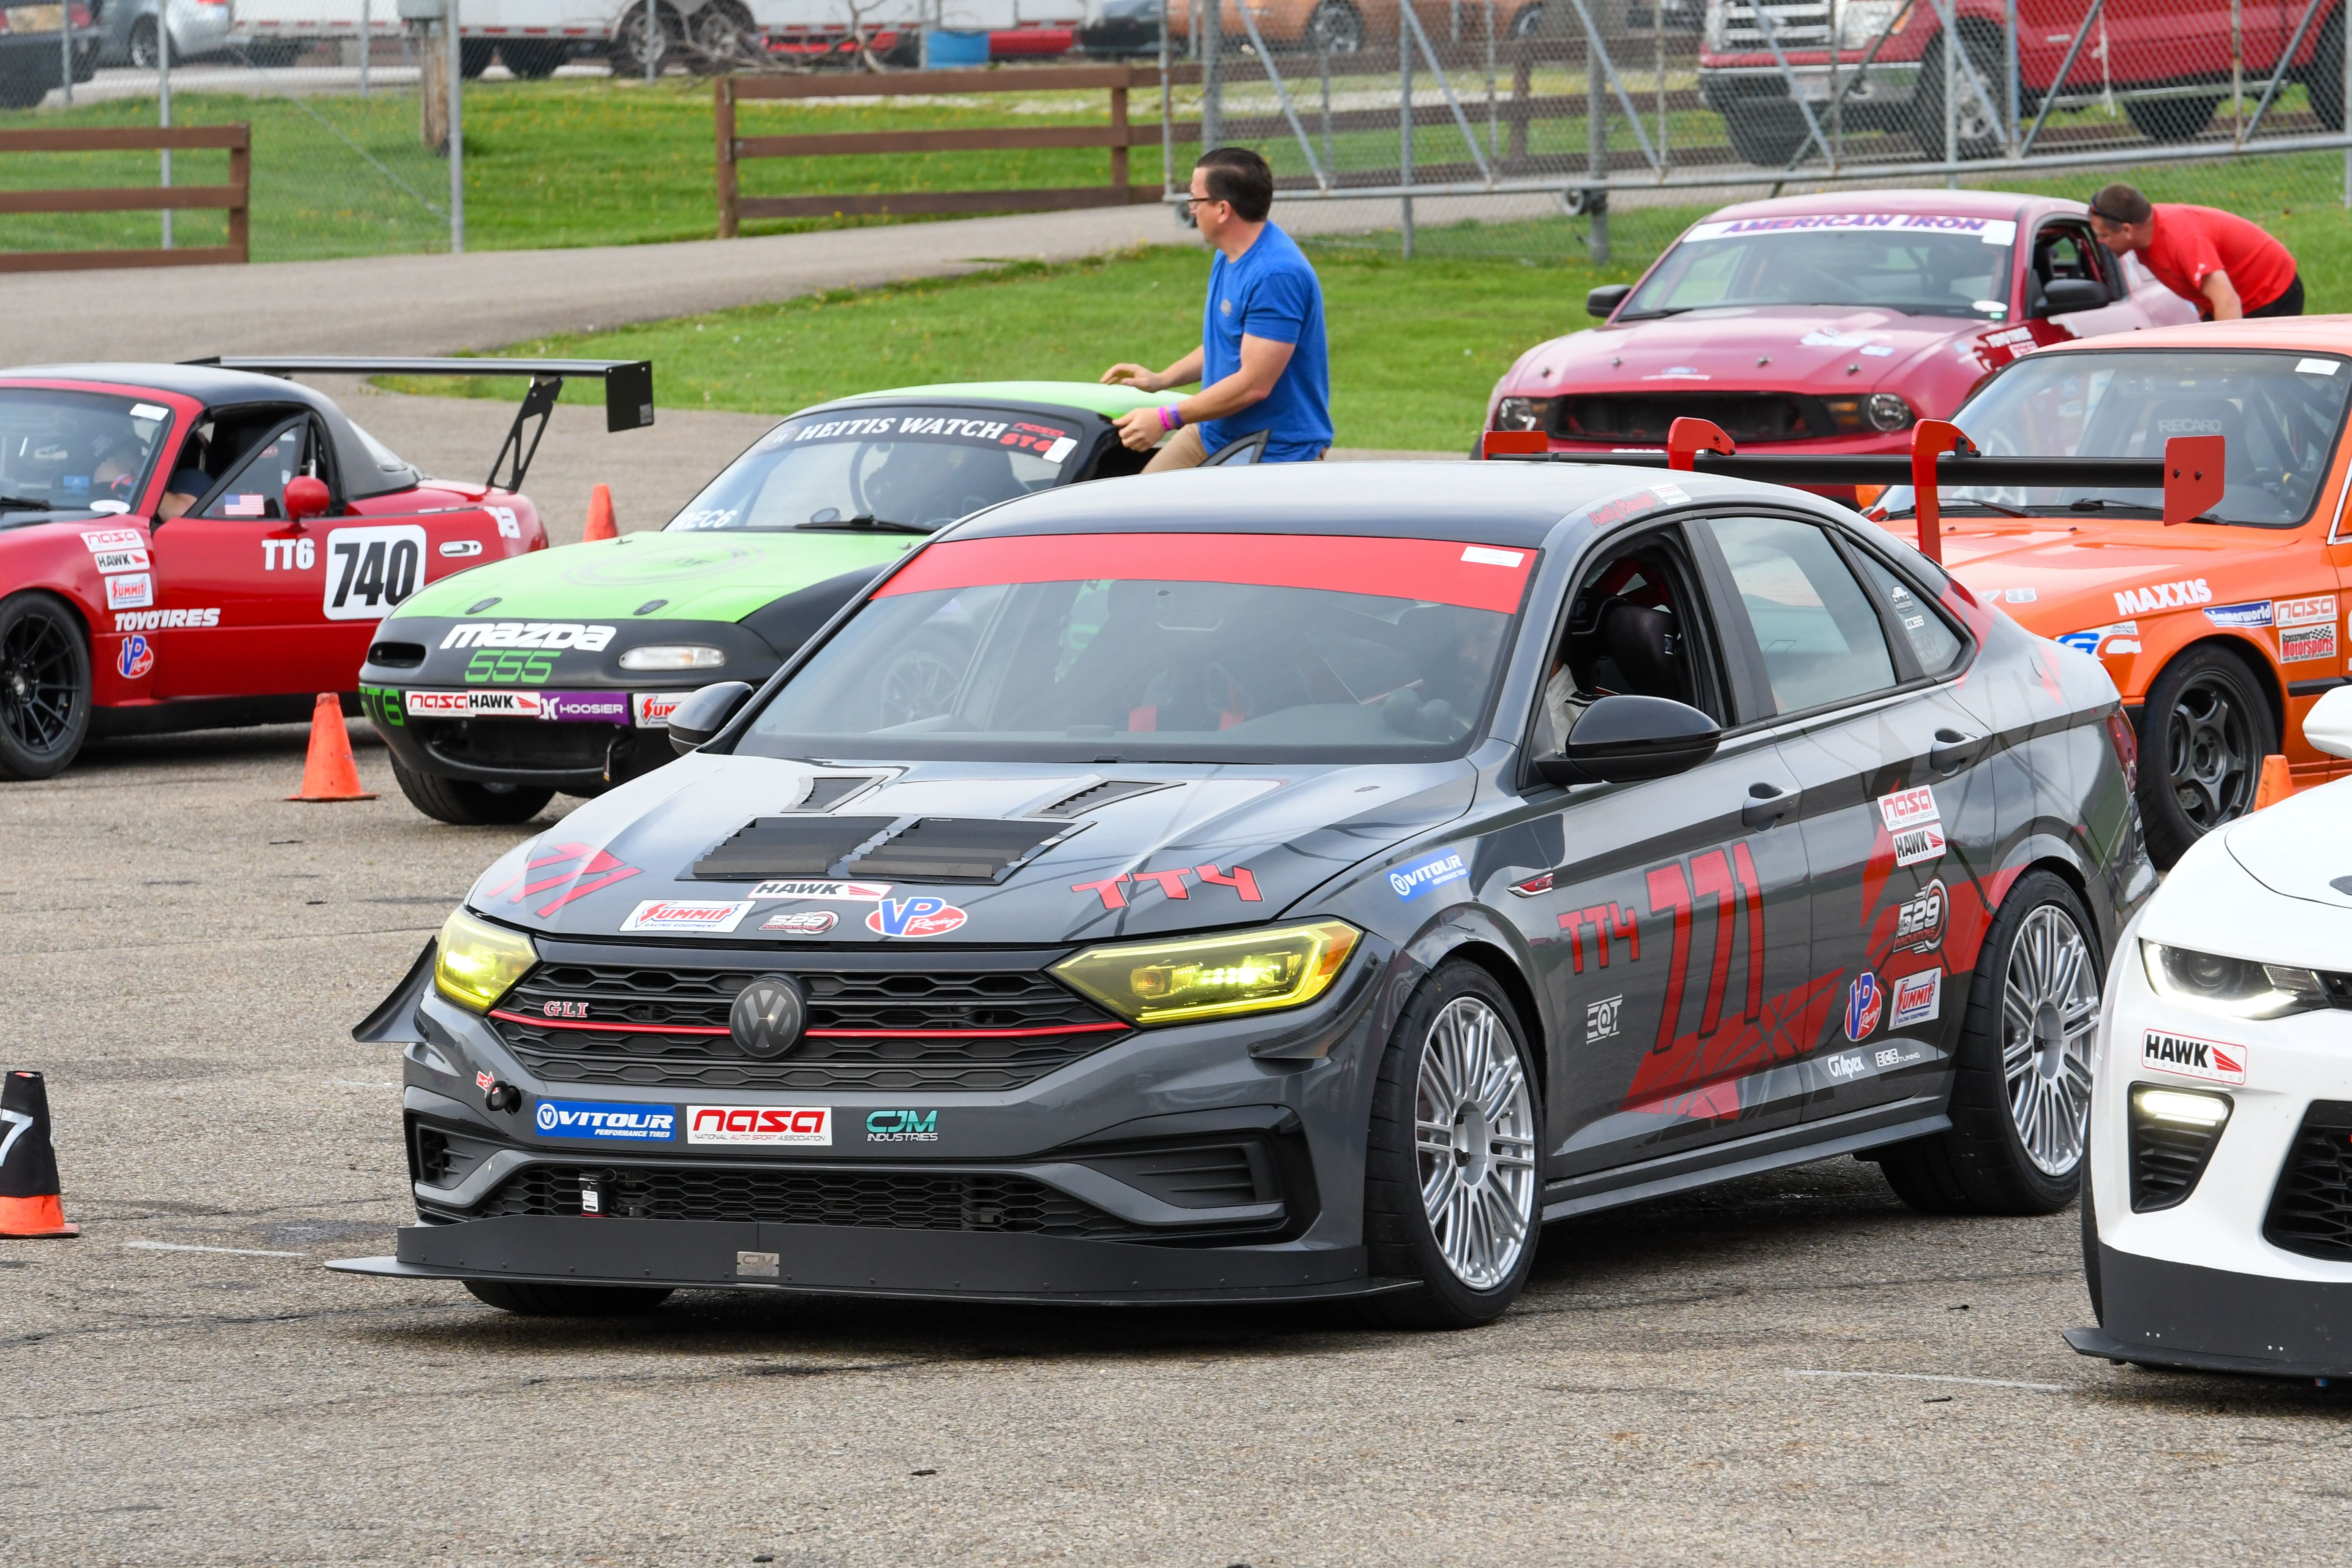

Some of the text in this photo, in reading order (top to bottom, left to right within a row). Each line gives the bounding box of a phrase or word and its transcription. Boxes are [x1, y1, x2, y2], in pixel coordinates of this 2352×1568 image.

[1721, 215, 1988, 234] AMERICAN IRON
[795, 417, 1009, 442] HEITIS WATCH
[2158, 419, 2222, 433] RECARO
[999, 433, 1053, 452] ST6
[88, 532, 137, 544] nasa
[97, 554, 131, 567] HAWK
[261, 538, 316, 570] TT6
[332, 540, 418, 607] 740
[2113, 579, 2212, 616] MAXXIS
[2205, 604, 2271, 621] bimmerworld
[2277, 598, 2333, 620] nasa
[122, 635, 146, 676] VP
[2283, 637, 2333, 658] Motorsports
[465, 650, 561, 683] 555
[469, 695, 514, 709] HAWK
[560, 704, 623, 714] HOOSIER
[642, 697, 678, 719] SUM
[1883, 789, 1932, 820] nasa
[1895, 830, 1929, 858] HAWK
[1403, 855, 1463, 886] VITOUR
[755, 883, 845, 895] HAWK
[640, 903, 732, 923] SUMMIT
[766, 915, 828, 926] 529
[879, 898, 945, 936] VP
[909, 916, 965, 931] Racing
[1898, 895, 1940, 936] 529
[1557, 901, 1640, 975] TT4
[1646, 839, 1764, 1054] 771
[544, 1000, 589, 1018] GLI
[1850, 972, 1875, 1040] VP
[1896, 979, 1933, 1018] SUMMIT
[1860, 1007, 1881, 1029] Racing
[1875, 1048, 1920, 1067] ECS TUNING
[2145, 1034, 2210, 1068] HAWK
[2144, 1059, 2243, 1082] PERFORMANCE
[559, 1111, 673, 1129] VITOUR
[693, 1110, 825, 1132] nasa
[594, 1128, 647, 1138] PERFORMANCE
[867, 1133, 938, 1141] INDUSTRIES
